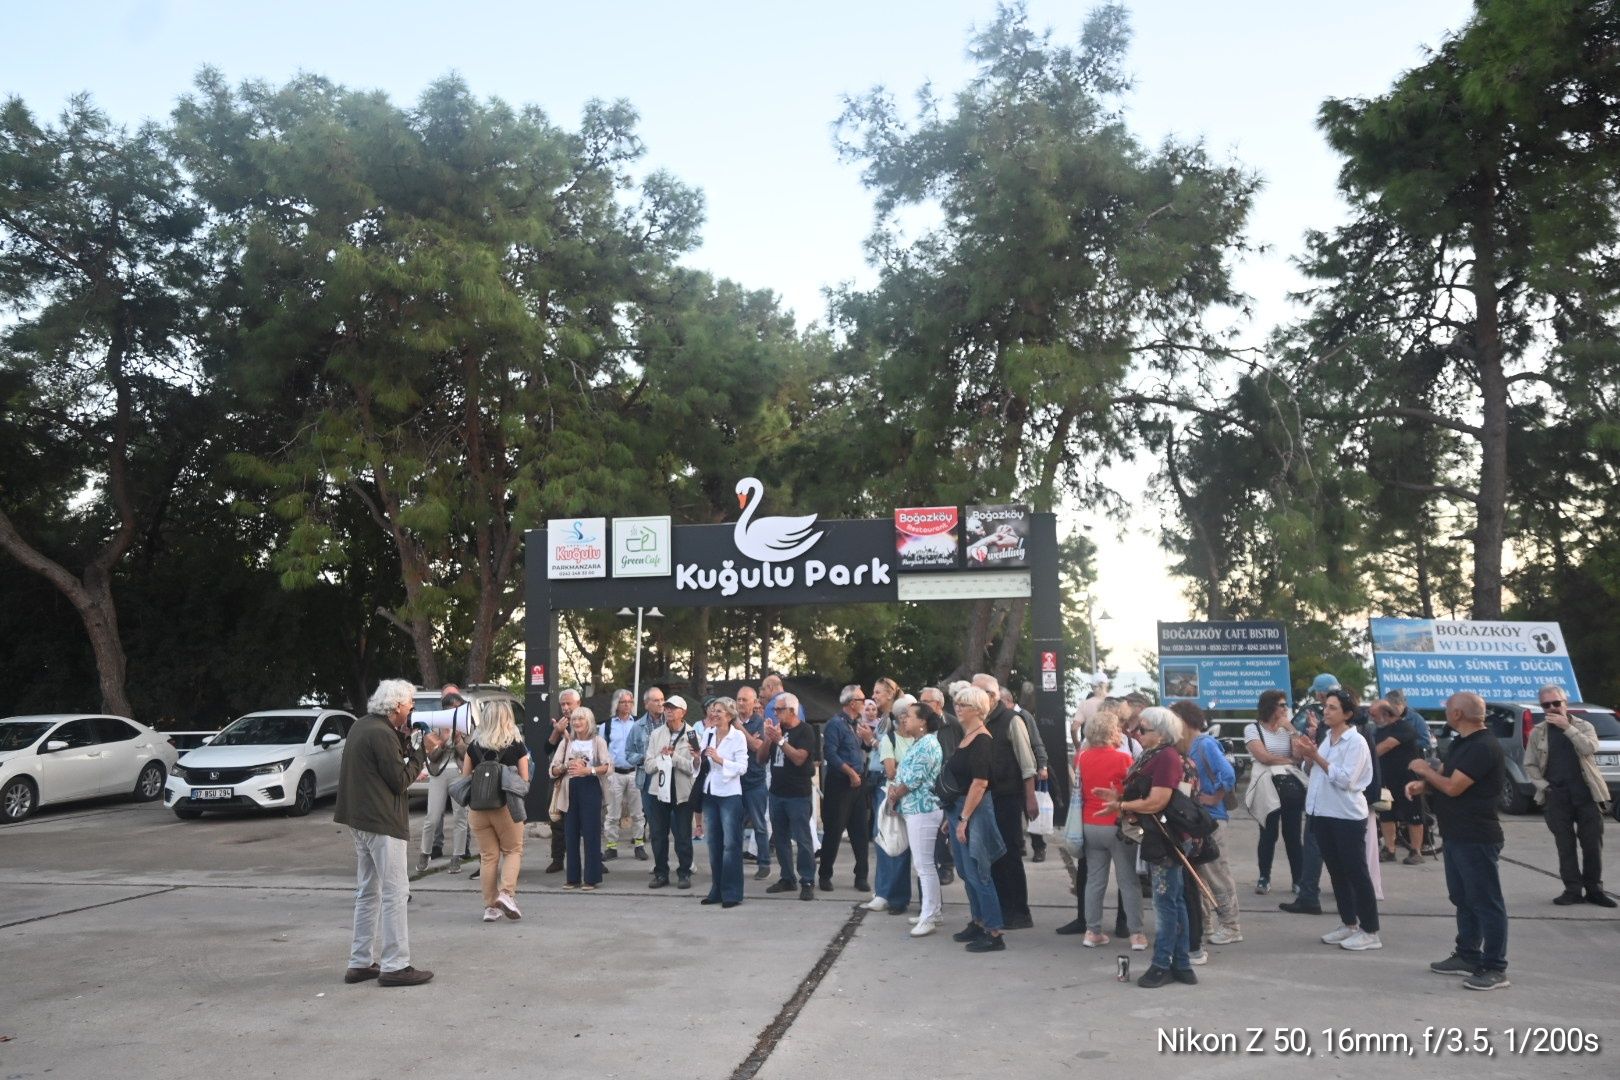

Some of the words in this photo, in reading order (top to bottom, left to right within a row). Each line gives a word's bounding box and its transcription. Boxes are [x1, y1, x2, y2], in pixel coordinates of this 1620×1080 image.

[900, 512, 952, 524] Boğazköy
[972, 510, 1024, 522] Boğazköy
[555, 545, 601, 564] Kuğulu
[676, 560, 794, 597] Kuğulu
[805, 557, 891, 587] Park
[1162, 627, 1221, 640] BOĞAZKÖY
[1225, 628, 1248, 639] CAFE
[1249, 628, 1279, 639] BISTRO
[1436, 623, 1521, 637] BOĞAZKÖY
[1439, 641, 1527, 652] WEDDING
[1382, 657, 1416, 671] NİŞAN
[1427, 659, 1455, 669] KINA
[1465, 658, 1509, 670] SÜNNET
[1520, 659, 1563, 671] DÜĞÜN
[1383, 673, 1413, 682] NİKAH
[1416, 674, 1457, 683] SONRASI
[1460, 675, 1492, 684] YEMEK
[1500, 676, 1531, 684] TOPLU
[1534, 676, 1566, 685] YEMEK
[1421, 688, 1434, 697] 234
